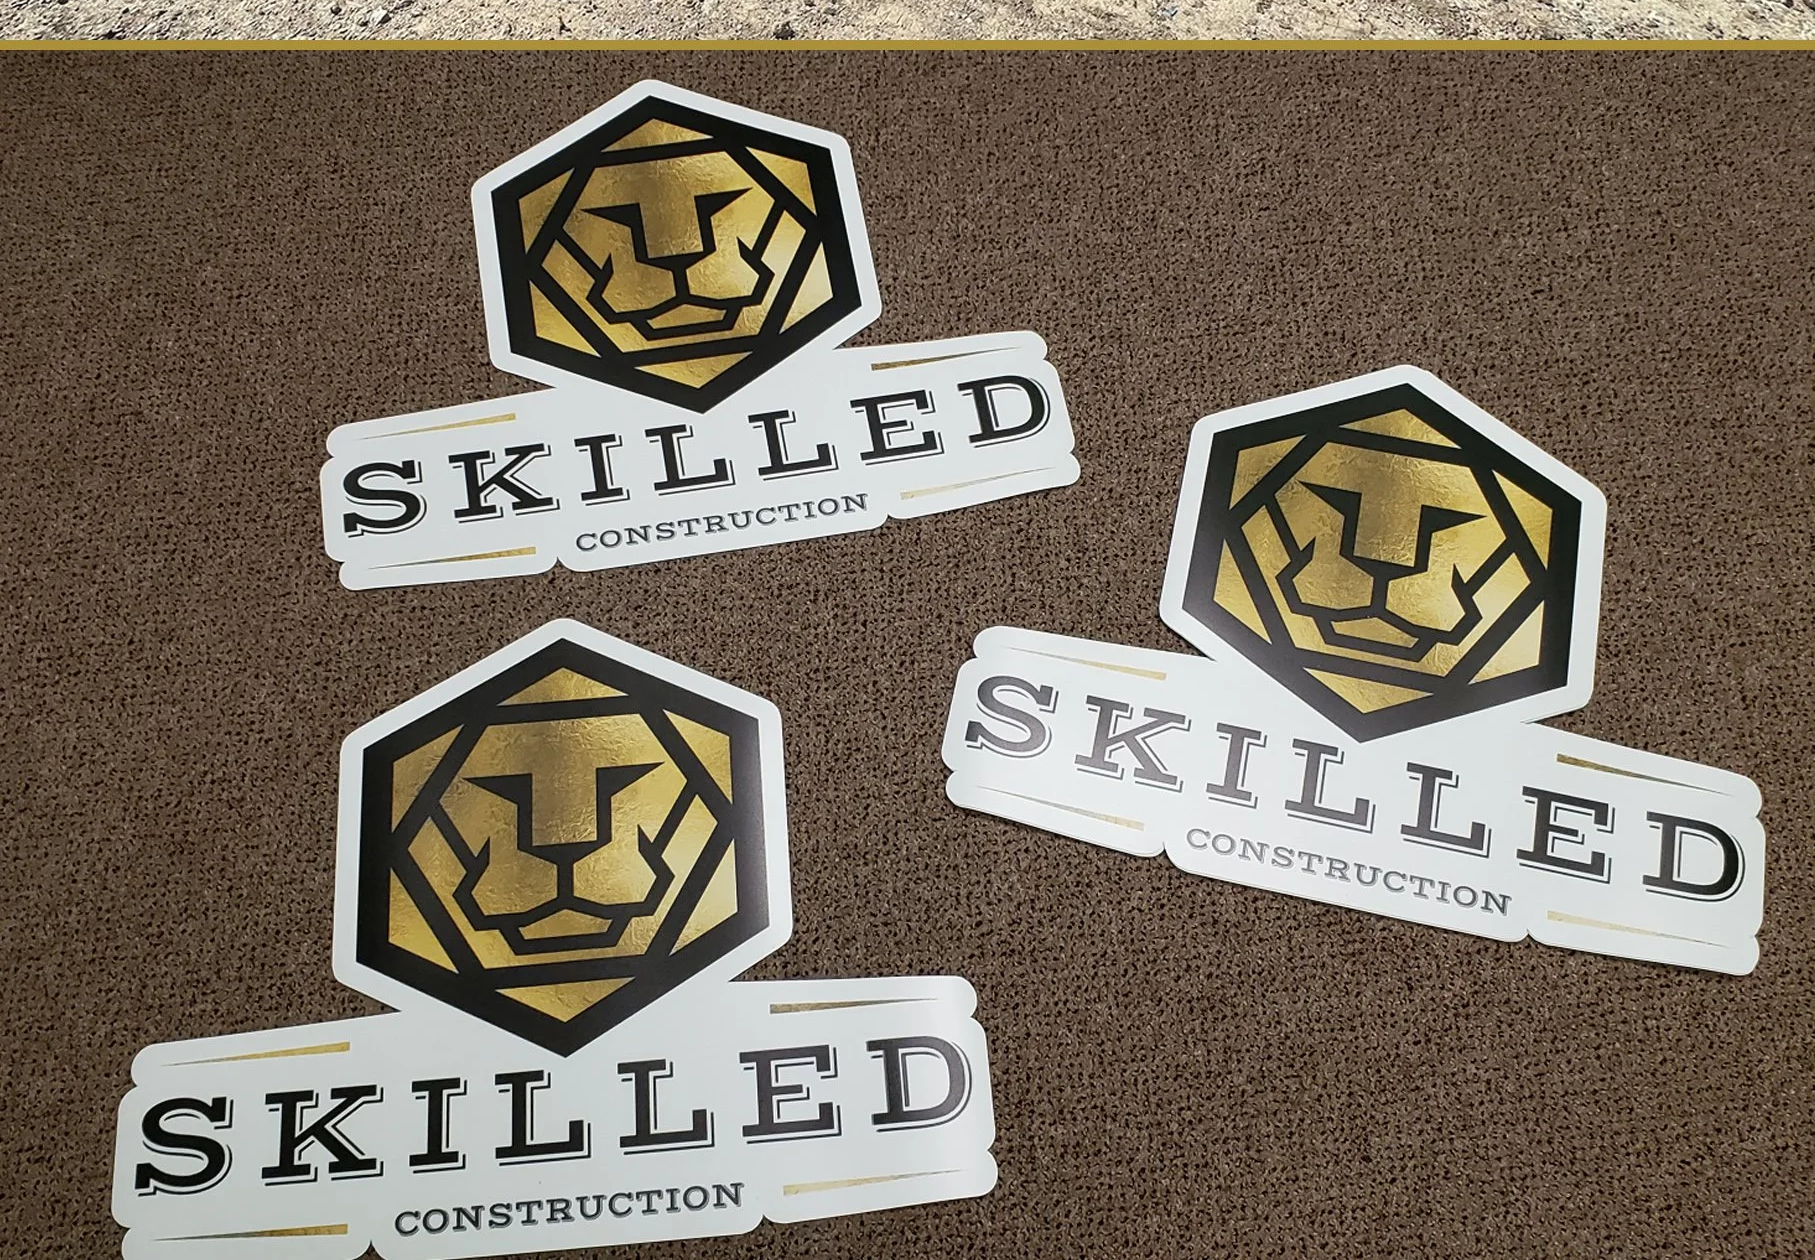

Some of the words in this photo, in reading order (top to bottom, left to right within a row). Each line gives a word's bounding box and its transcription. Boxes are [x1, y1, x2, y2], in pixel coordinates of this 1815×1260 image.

[342, 375, 1051, 539] SKILLED
[574, 492, 870, 553] CONSTRUCTION
[964, 675, 1746, 903] SKILLED
[1186, 828, 1512, 917] CONSTRUCTION
[134, 1035, 973, 1198] SKILLED
[394, 1182, 746, 1238] CONSTRUCTION
